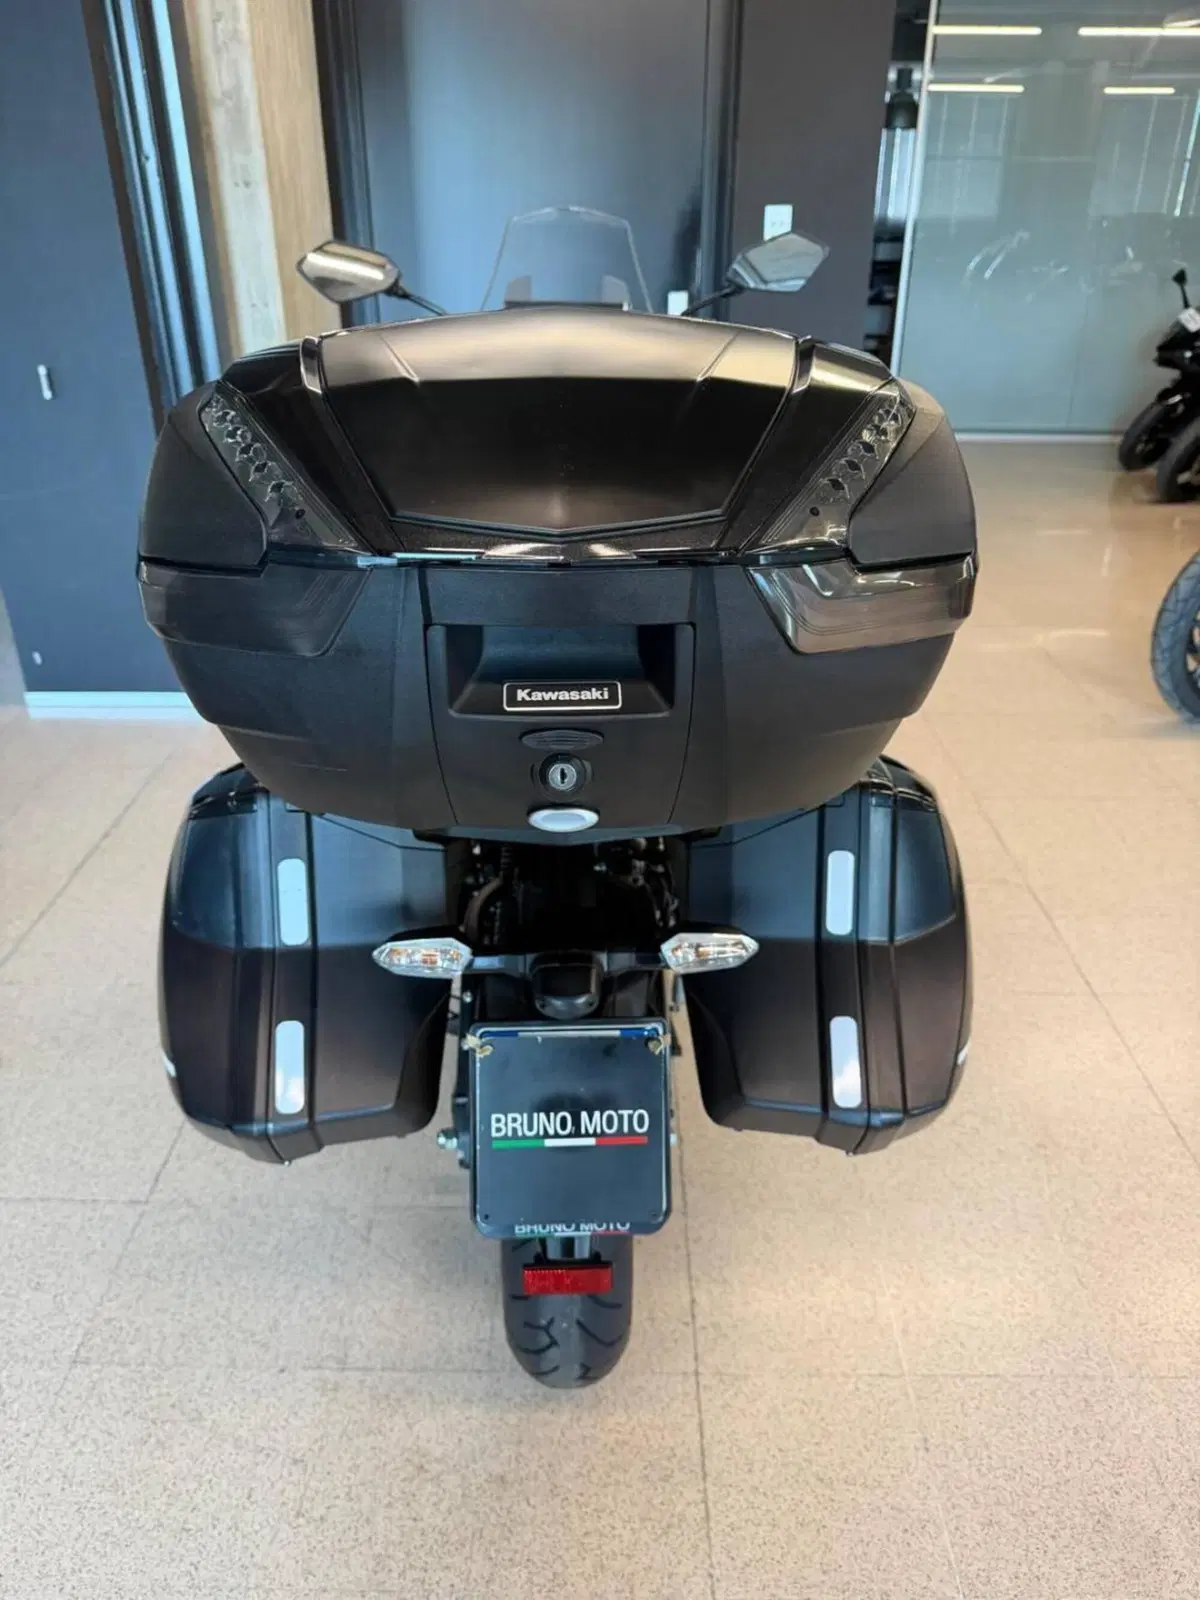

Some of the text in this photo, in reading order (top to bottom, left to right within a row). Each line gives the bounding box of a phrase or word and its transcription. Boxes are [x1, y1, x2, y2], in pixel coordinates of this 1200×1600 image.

[516, 687, 609, 702] Kawasaki
[490, 1108, 650, 1138] BRUNO MOTO
